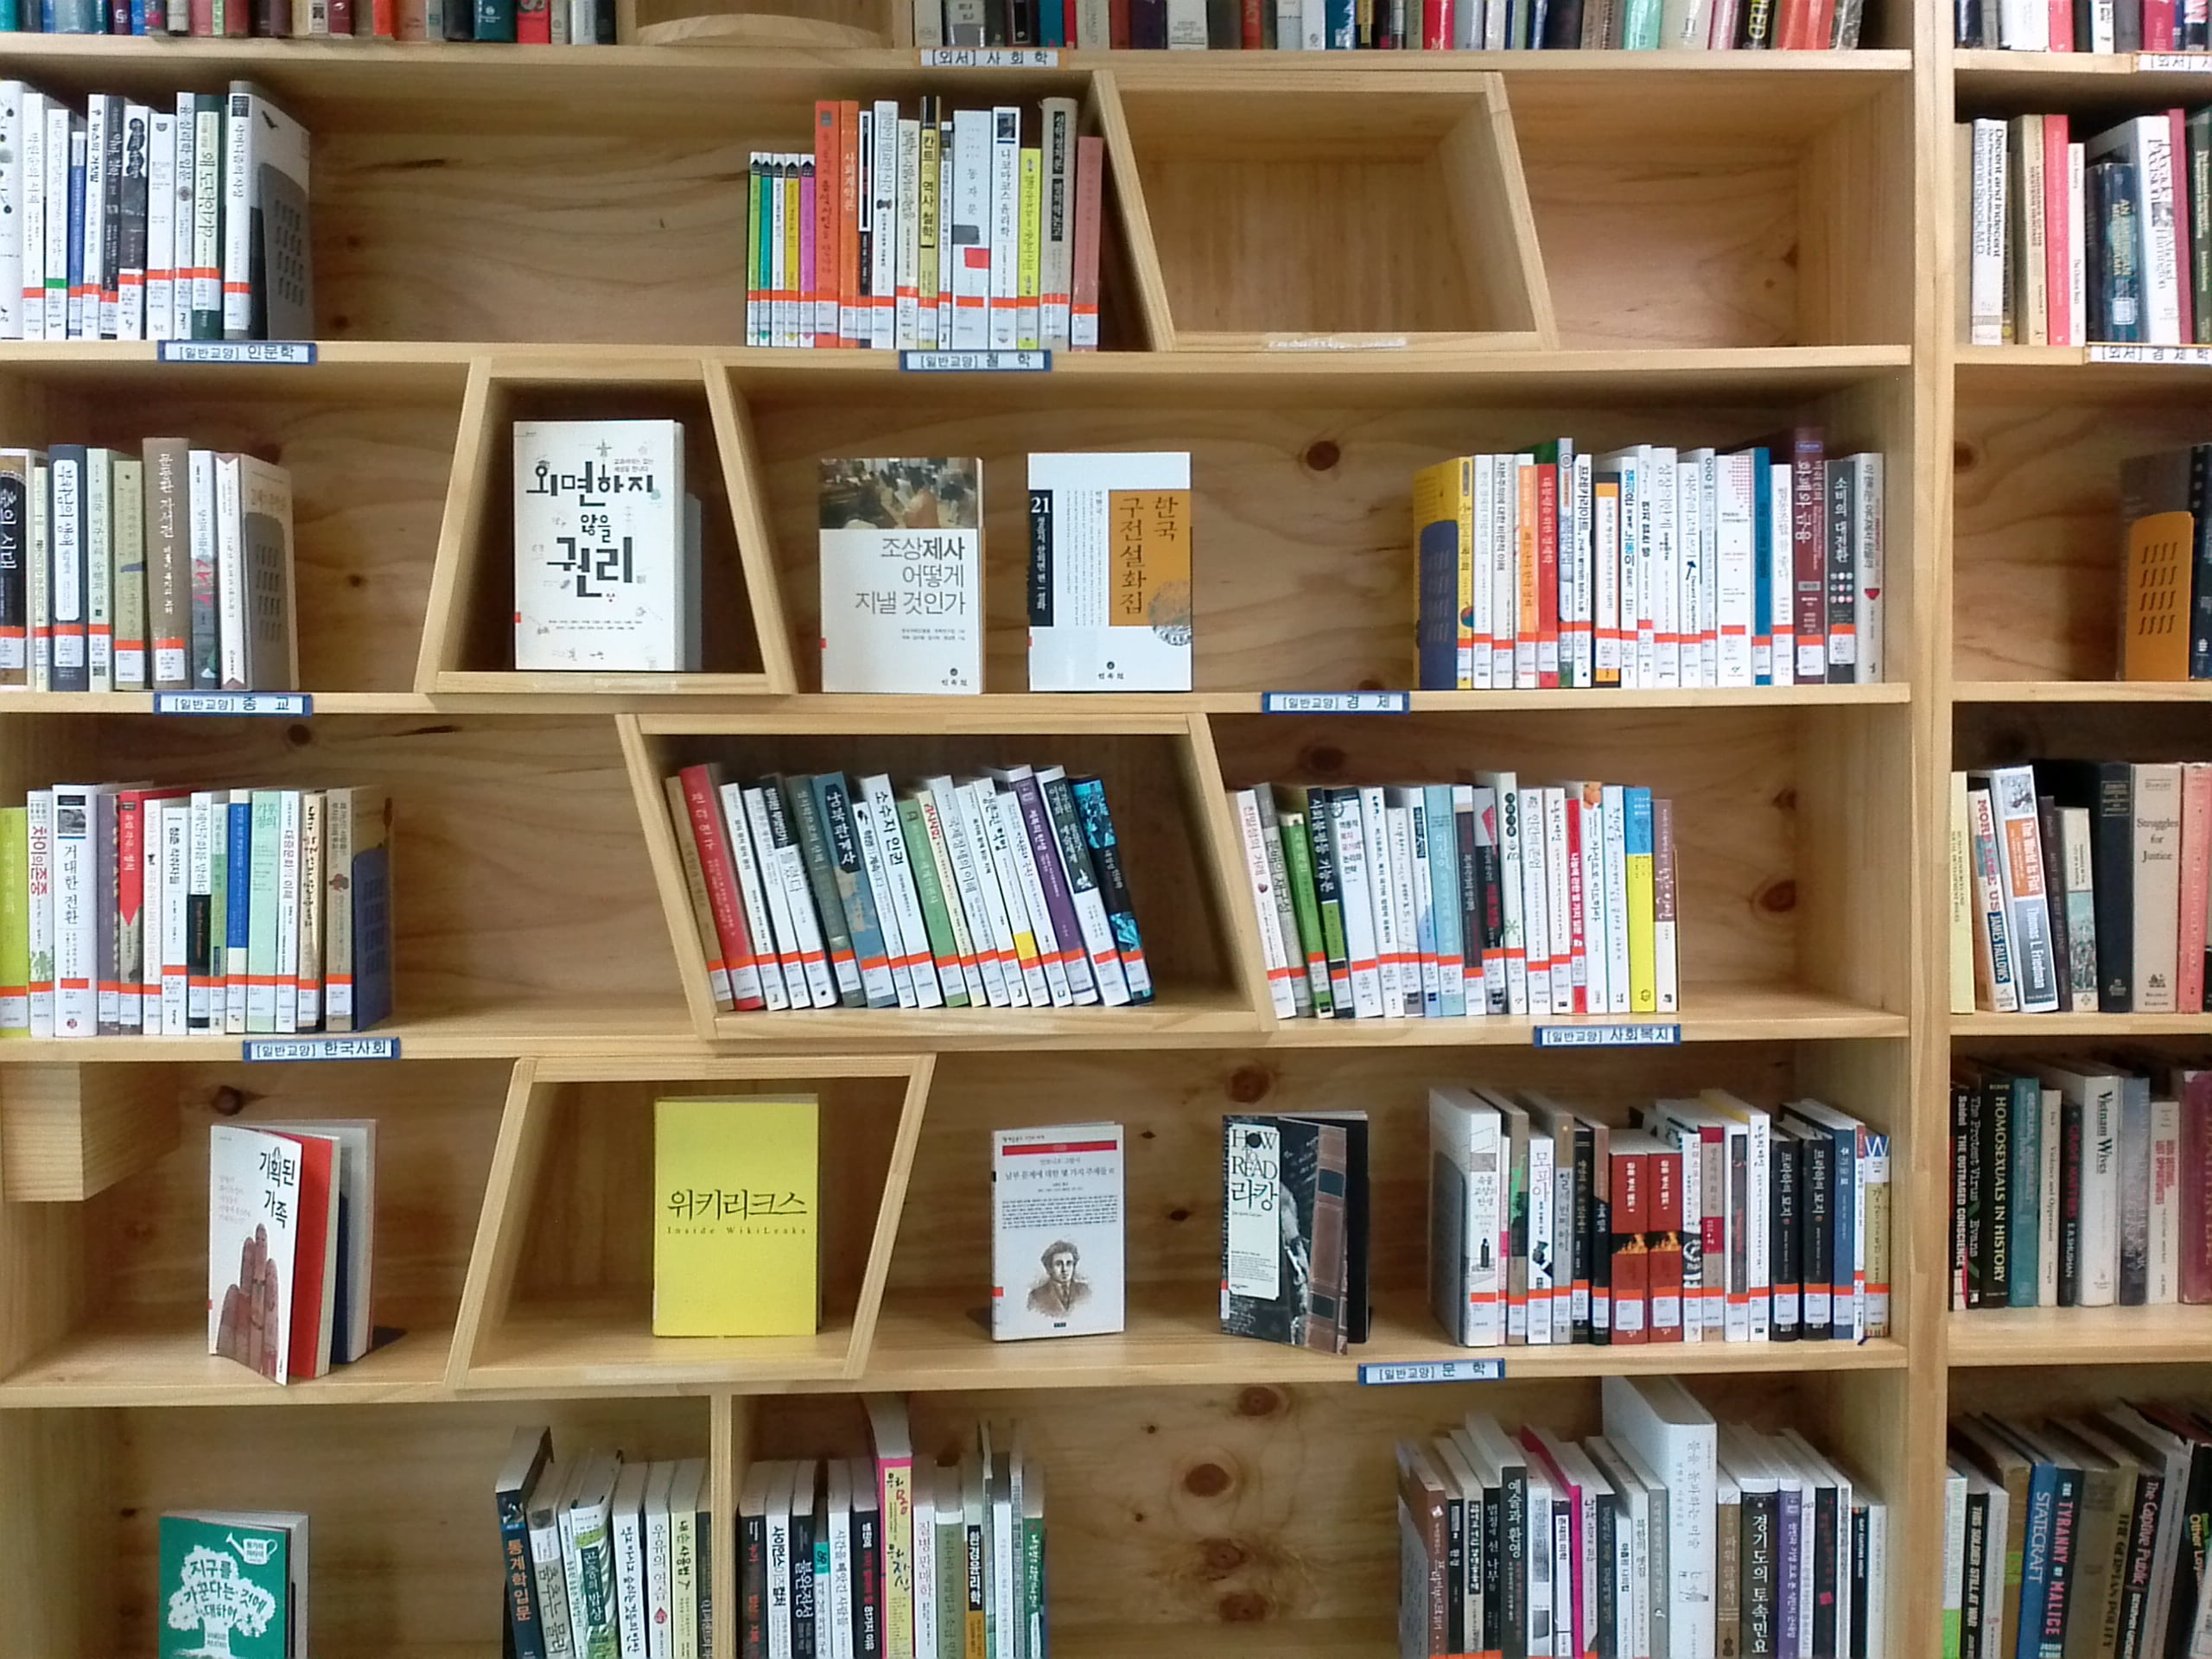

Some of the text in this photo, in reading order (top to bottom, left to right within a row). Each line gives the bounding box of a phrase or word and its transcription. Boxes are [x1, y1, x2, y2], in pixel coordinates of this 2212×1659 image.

[200, 151, 215, 167] 왜
[1995, 128, 2004, 173] Decent
[922, 181, 934, 207] 역사
[1993, 204, 2002, 257] Indecent
[180, 346, 294, 361] [일반교양] 인문학
[920, 355, 978, 369] [일반교양]
[526, 461, 654, 506] 외면하지
[58, 469, 74, 546] 부처님의 생애
[1031, 497, 1051, 513] 21
[1154, 496, 1179, 542] 한국
[581, 514, 611, 543] 않을
[1796, 512, 1812, 543] 금융
[546, 537, 632, 597] 권리
[880, 537, 965, 560] 조상제사
[1120, 497, 1147, 615] 구전설화집
[902, 564, 964, 588] 어떻게
[855, 592, 966, 614] 지낼 것인가
[175, 698, 234, 712] [일반교양]
[1283, 696, 1339, 709] [일반교양]
[826, 789, 857, 865] 남북관계사
[874, 791, 904, 866] 소수자 인권
[2137, 817, 2178, 830] Struggles
[2151, 834, 2164, 844] for
[1978, 799, 1993, 845] MORE
[1987, 890, 2001, 912] US
[2021, 821, 2039, 893] The World Flat
[2142, 850, 2173, 863] Justice
[63, 844, 79, 925] 거대한 전환
[1991, 913, 2010, 982] JAMES FALLOWS
[2025, 906, 2044, 989] Thomas Friedman
[257, 1042, 386, 1057] [일반교양] 한국사회
[1548, 1028, 1669, 1044] [일반교양] 사회복지
[1231, 1128, 1278, 1150] HOW
[2097, 1090, 2113, 1175] Vietnam Wives
[259, 1149, 296, 1188] 기획된
[1231, 1155, 1278, 1181] READ
[1779, 1151, 1793, 1217] 프라하의 묘지
[1813, 1147, 1825, 1214] 프라하의 묘지
[1969, 1096, 1980, 1258] The Protest Virus Evans
[667, 1189, 807, 1221] 위키리크스
[1231, 1181, 1279, 1211] 라캉
[1955, 1135, 1967, 1267] THE OUTRAGED CONSCIENCE
[1993, 1096, 2007, 1282] HOMOSEXUALS IN HISTORY
[264, 1190, 289, 1229] 가족
[668, 1226, 807, 1235] Inside WikiLeaks
[1379, 1367, 1435, 1380] [일반교양]
[620, 1526, 633, 1543] 먹고
[677, 1521, 692, 1576] 내 손 사용법
[2028, 1491, 2050, 1584] STATECRAFT
[2132, 1481, 2159, 1586] The Captive Public
[2189, 1513, 2202, 1548] Other
[190, 1559, 232, 1580] 지구를
[623, 1545, 634, 1572] 마시고
[837, 1529, 849, 1626] 시간을 빼앗긴 사람들
[1967, 1505, 1982, 1627] THIS SOLDIER STILL AT WAR
[2045, 1482, 2074, 1636] THE TYRANNY OF MALICE
[183, 1581, 267, 1614] 가꾼다는 것에
[538, 1564, 562, 1620] 춤추는
[626, 1575, 638, 1603] 숨쉬는
[795, 1559, 814, 1619] 불완전성
[1751, 1513, 1770, 1654] 경기도의 토속민요
[625, 1603, 639, 1631] 것들의
[864, 1605, 875, 1652] 81가지 이유
